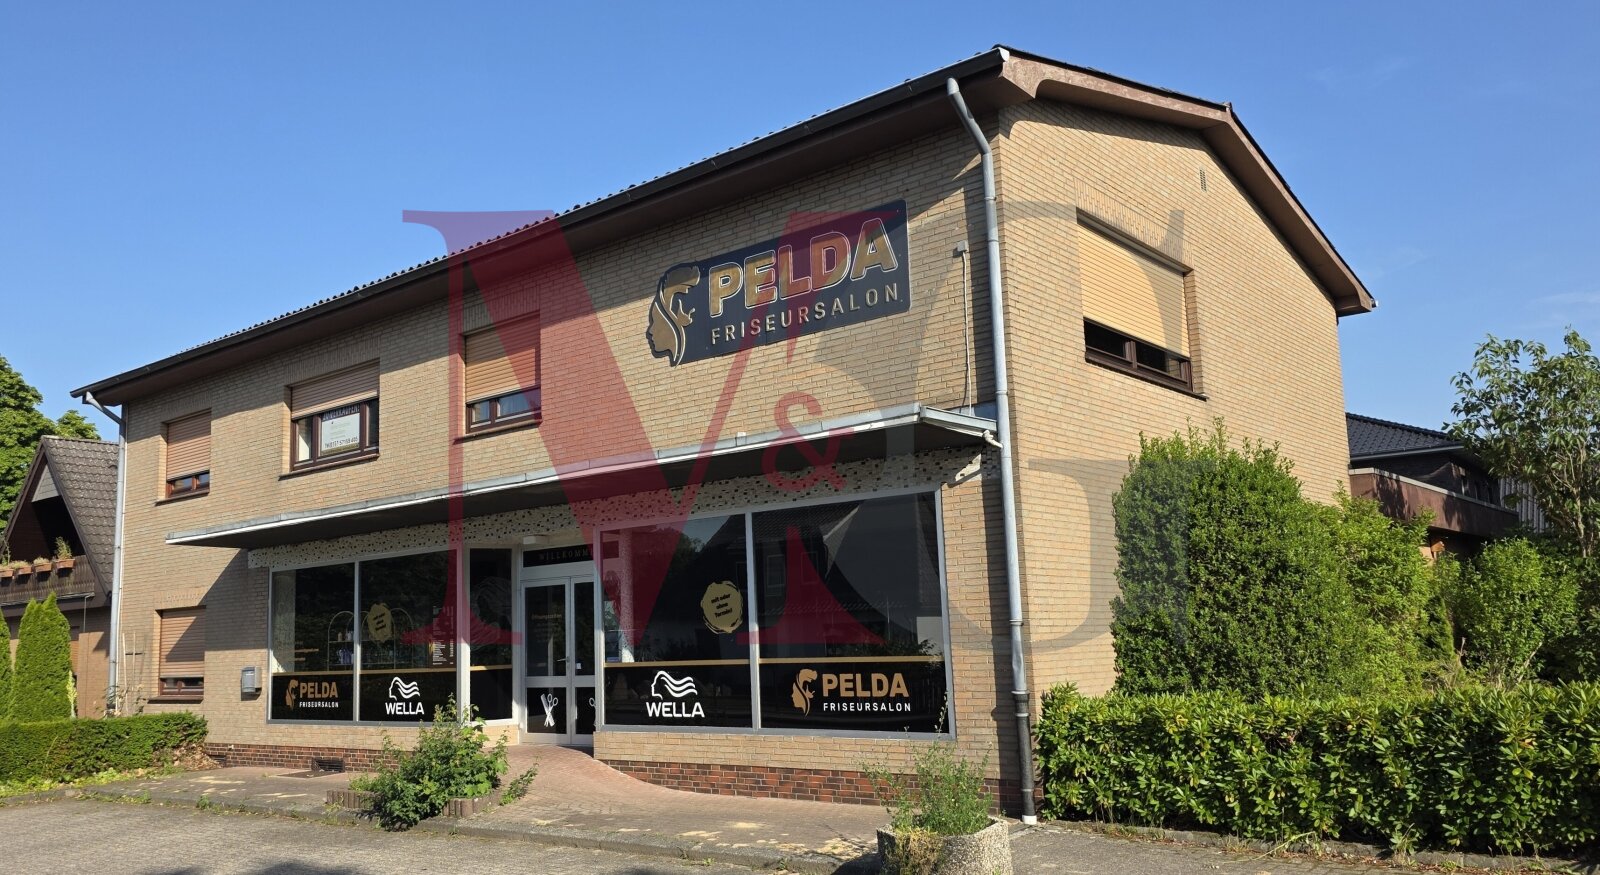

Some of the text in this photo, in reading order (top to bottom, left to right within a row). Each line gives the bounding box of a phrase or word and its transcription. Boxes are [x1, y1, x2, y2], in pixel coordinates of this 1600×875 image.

[708, 217, 899, 318] PELDA
[711, 283, 898, 345] FRISEURSALON
[299, 681, 339, 699] PELDA
[823, 673, 910, 698] PELDA
[385, 701, 425, 716] WELLA
[645, 701, 705, 718] WELLA
[823, 702, 911, 713] FRISEURSALON
